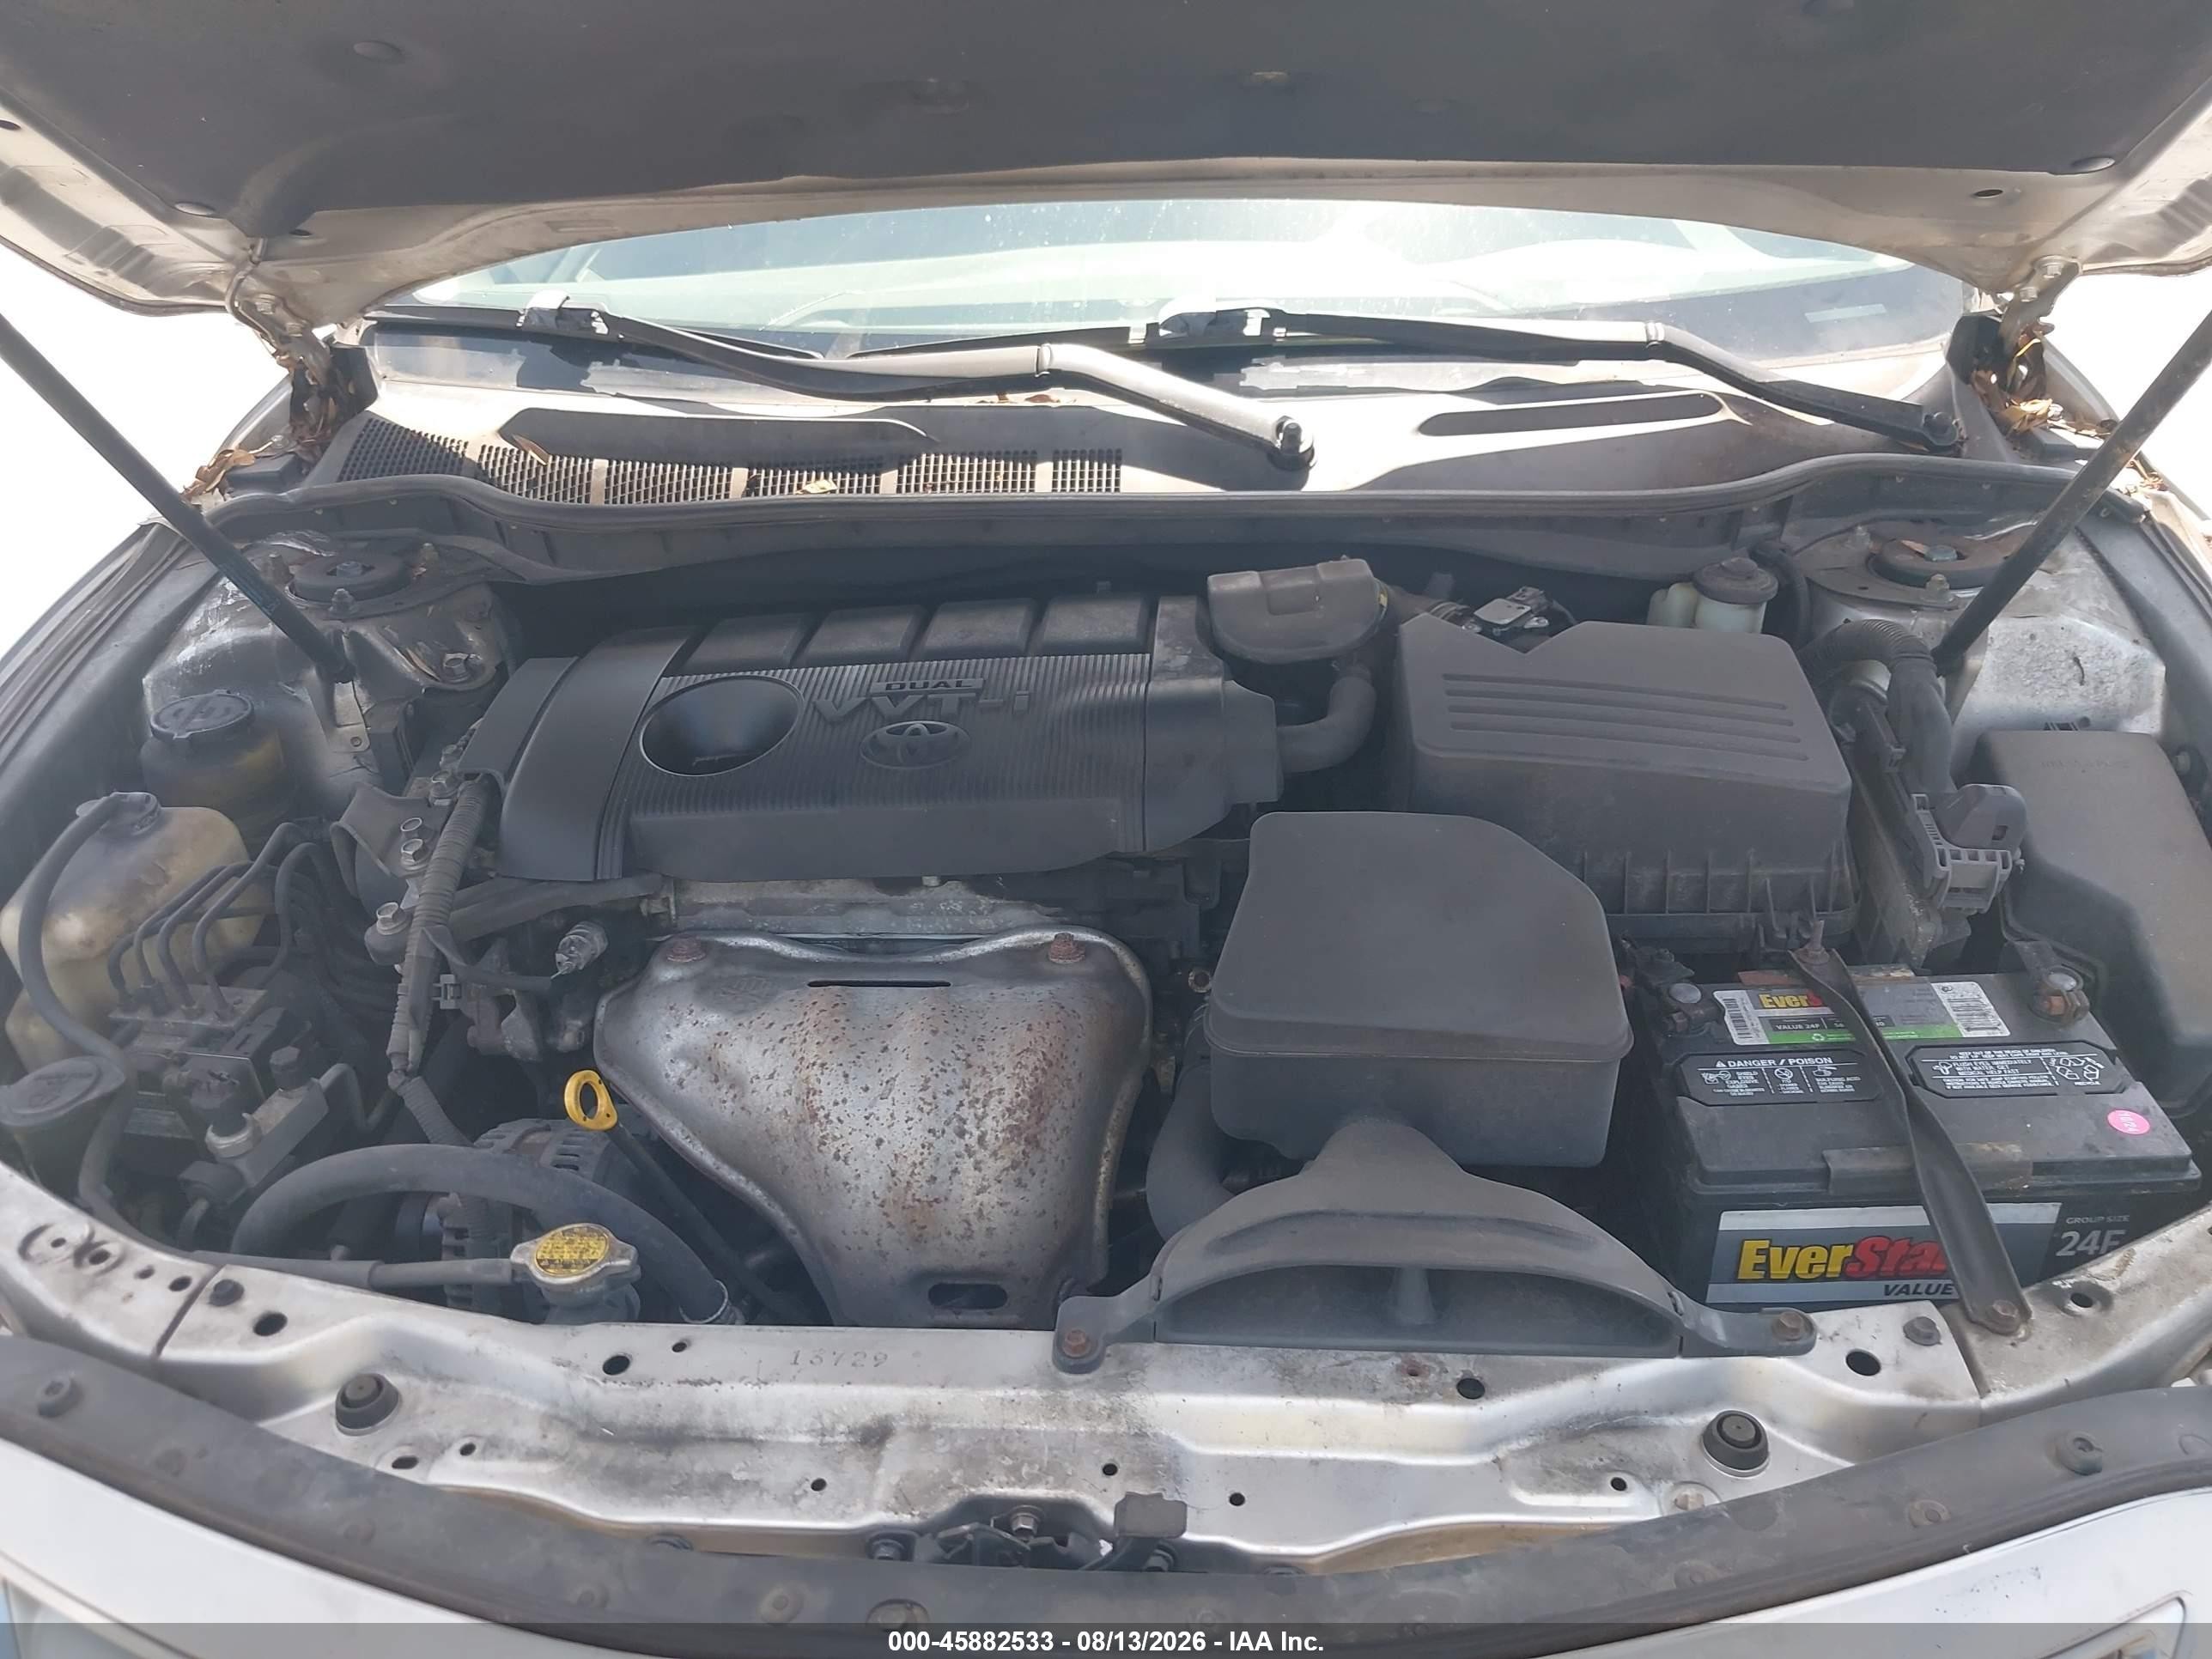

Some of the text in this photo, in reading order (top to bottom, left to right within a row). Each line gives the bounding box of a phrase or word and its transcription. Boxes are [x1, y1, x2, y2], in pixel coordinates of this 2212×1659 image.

[885, 679, 975, 691] DUAL
[1727, 1059, 1778, 1067] DANGER
[1788, 1057, 1834, 1066] POISON
[2065, 1214, 2130, 1224] GROUP SIZE
[2055, 1229, 2127, 1257] 24F
[1736, 1236, 1948, 1280] EverSta
[1883, 1283, 1954, 1297] VALUE
